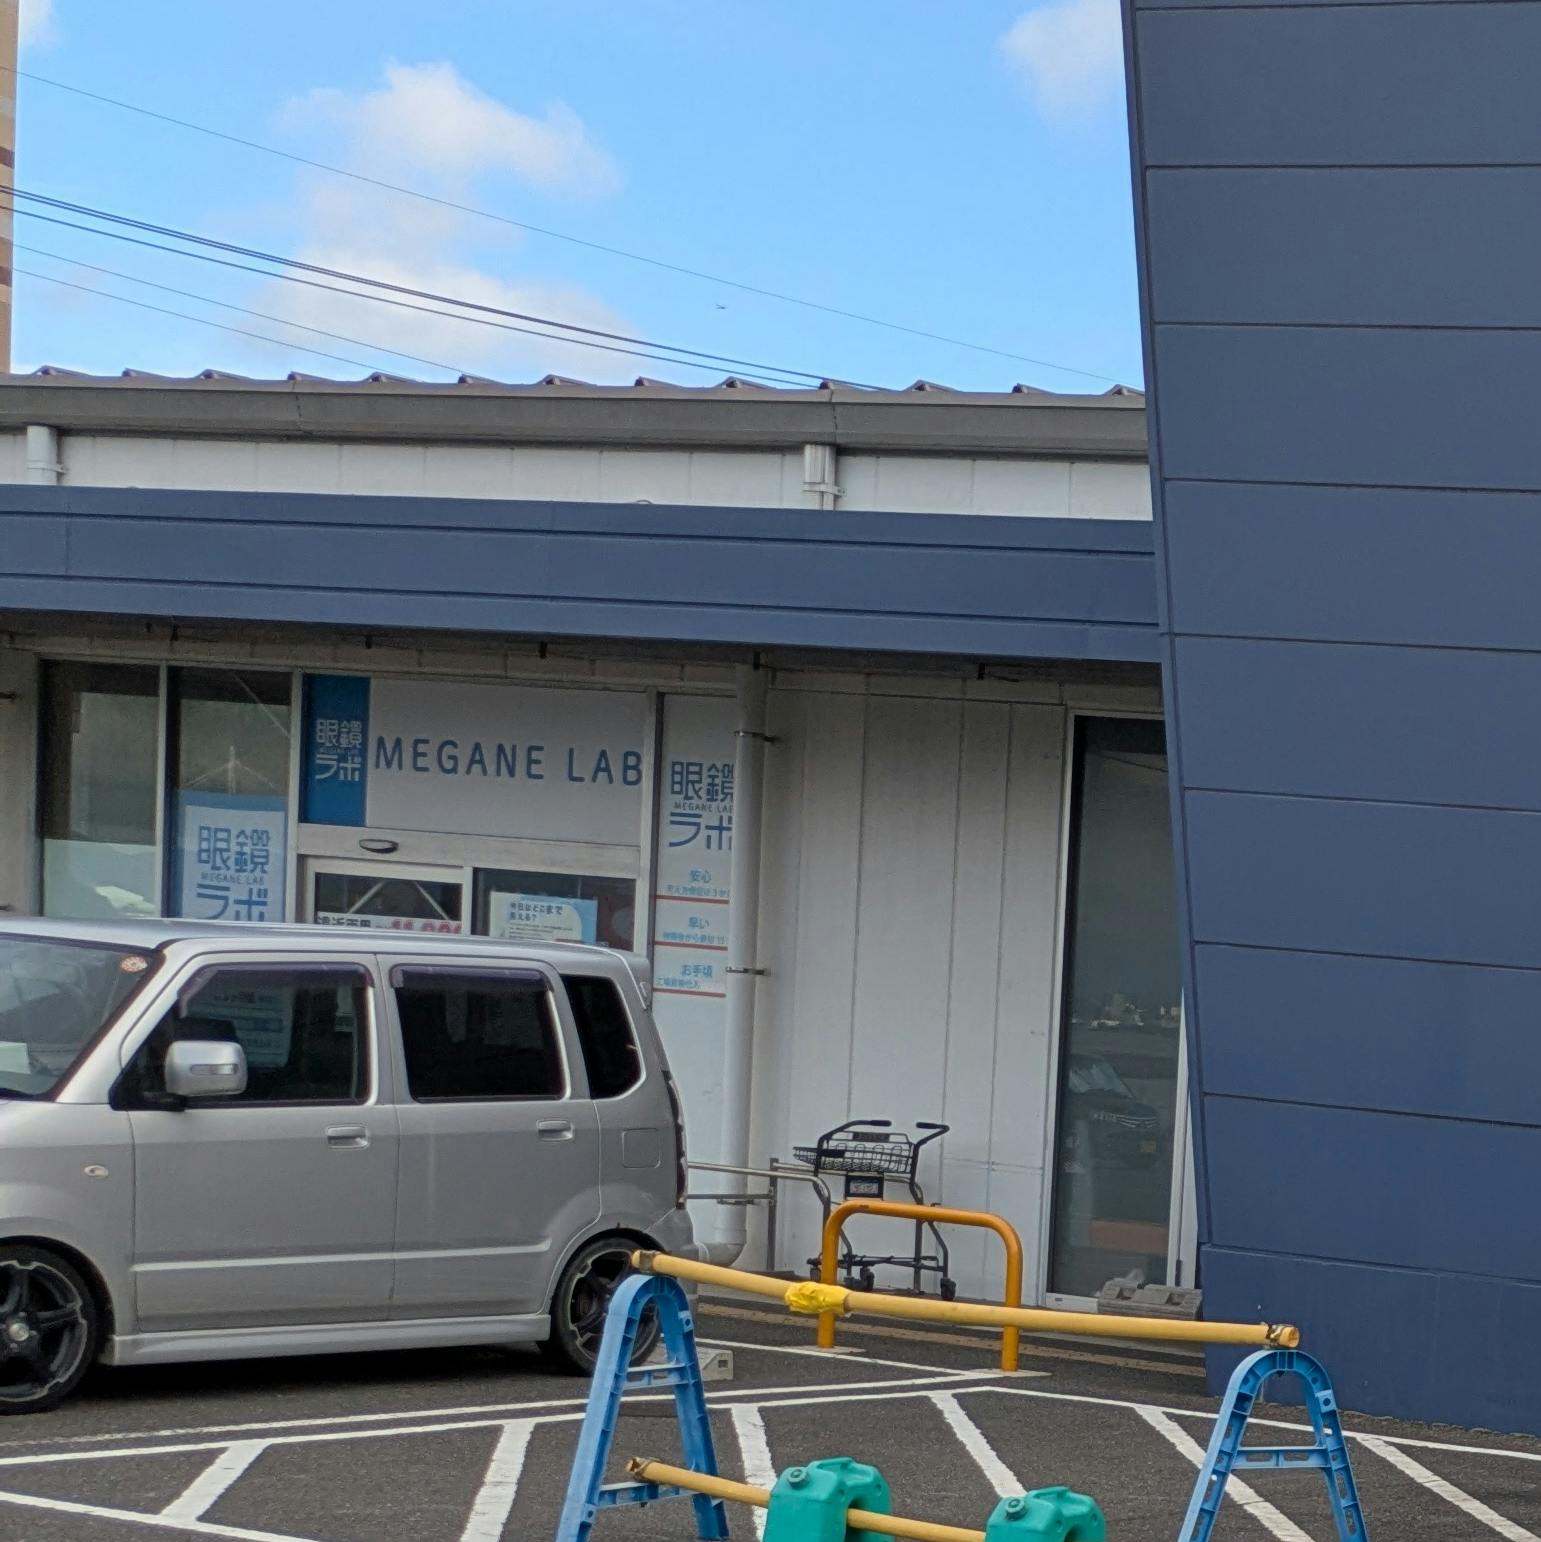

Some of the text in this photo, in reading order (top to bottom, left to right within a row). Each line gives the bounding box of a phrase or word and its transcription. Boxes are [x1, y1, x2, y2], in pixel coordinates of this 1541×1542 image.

[316, 719, 362, 748] 眼鏡
[315, 751, 362, 781] ラボ
[375, 735, 643, 786] MEGANE LAB
[674, 801, 713, 813] MEGANE
[669, 812, 733, 850] ラボ
[197, 825, 270, 874] 眼鏡
[200, 871, 243, 885] MEGANE
[196, 882, 269, 922] ラボ
